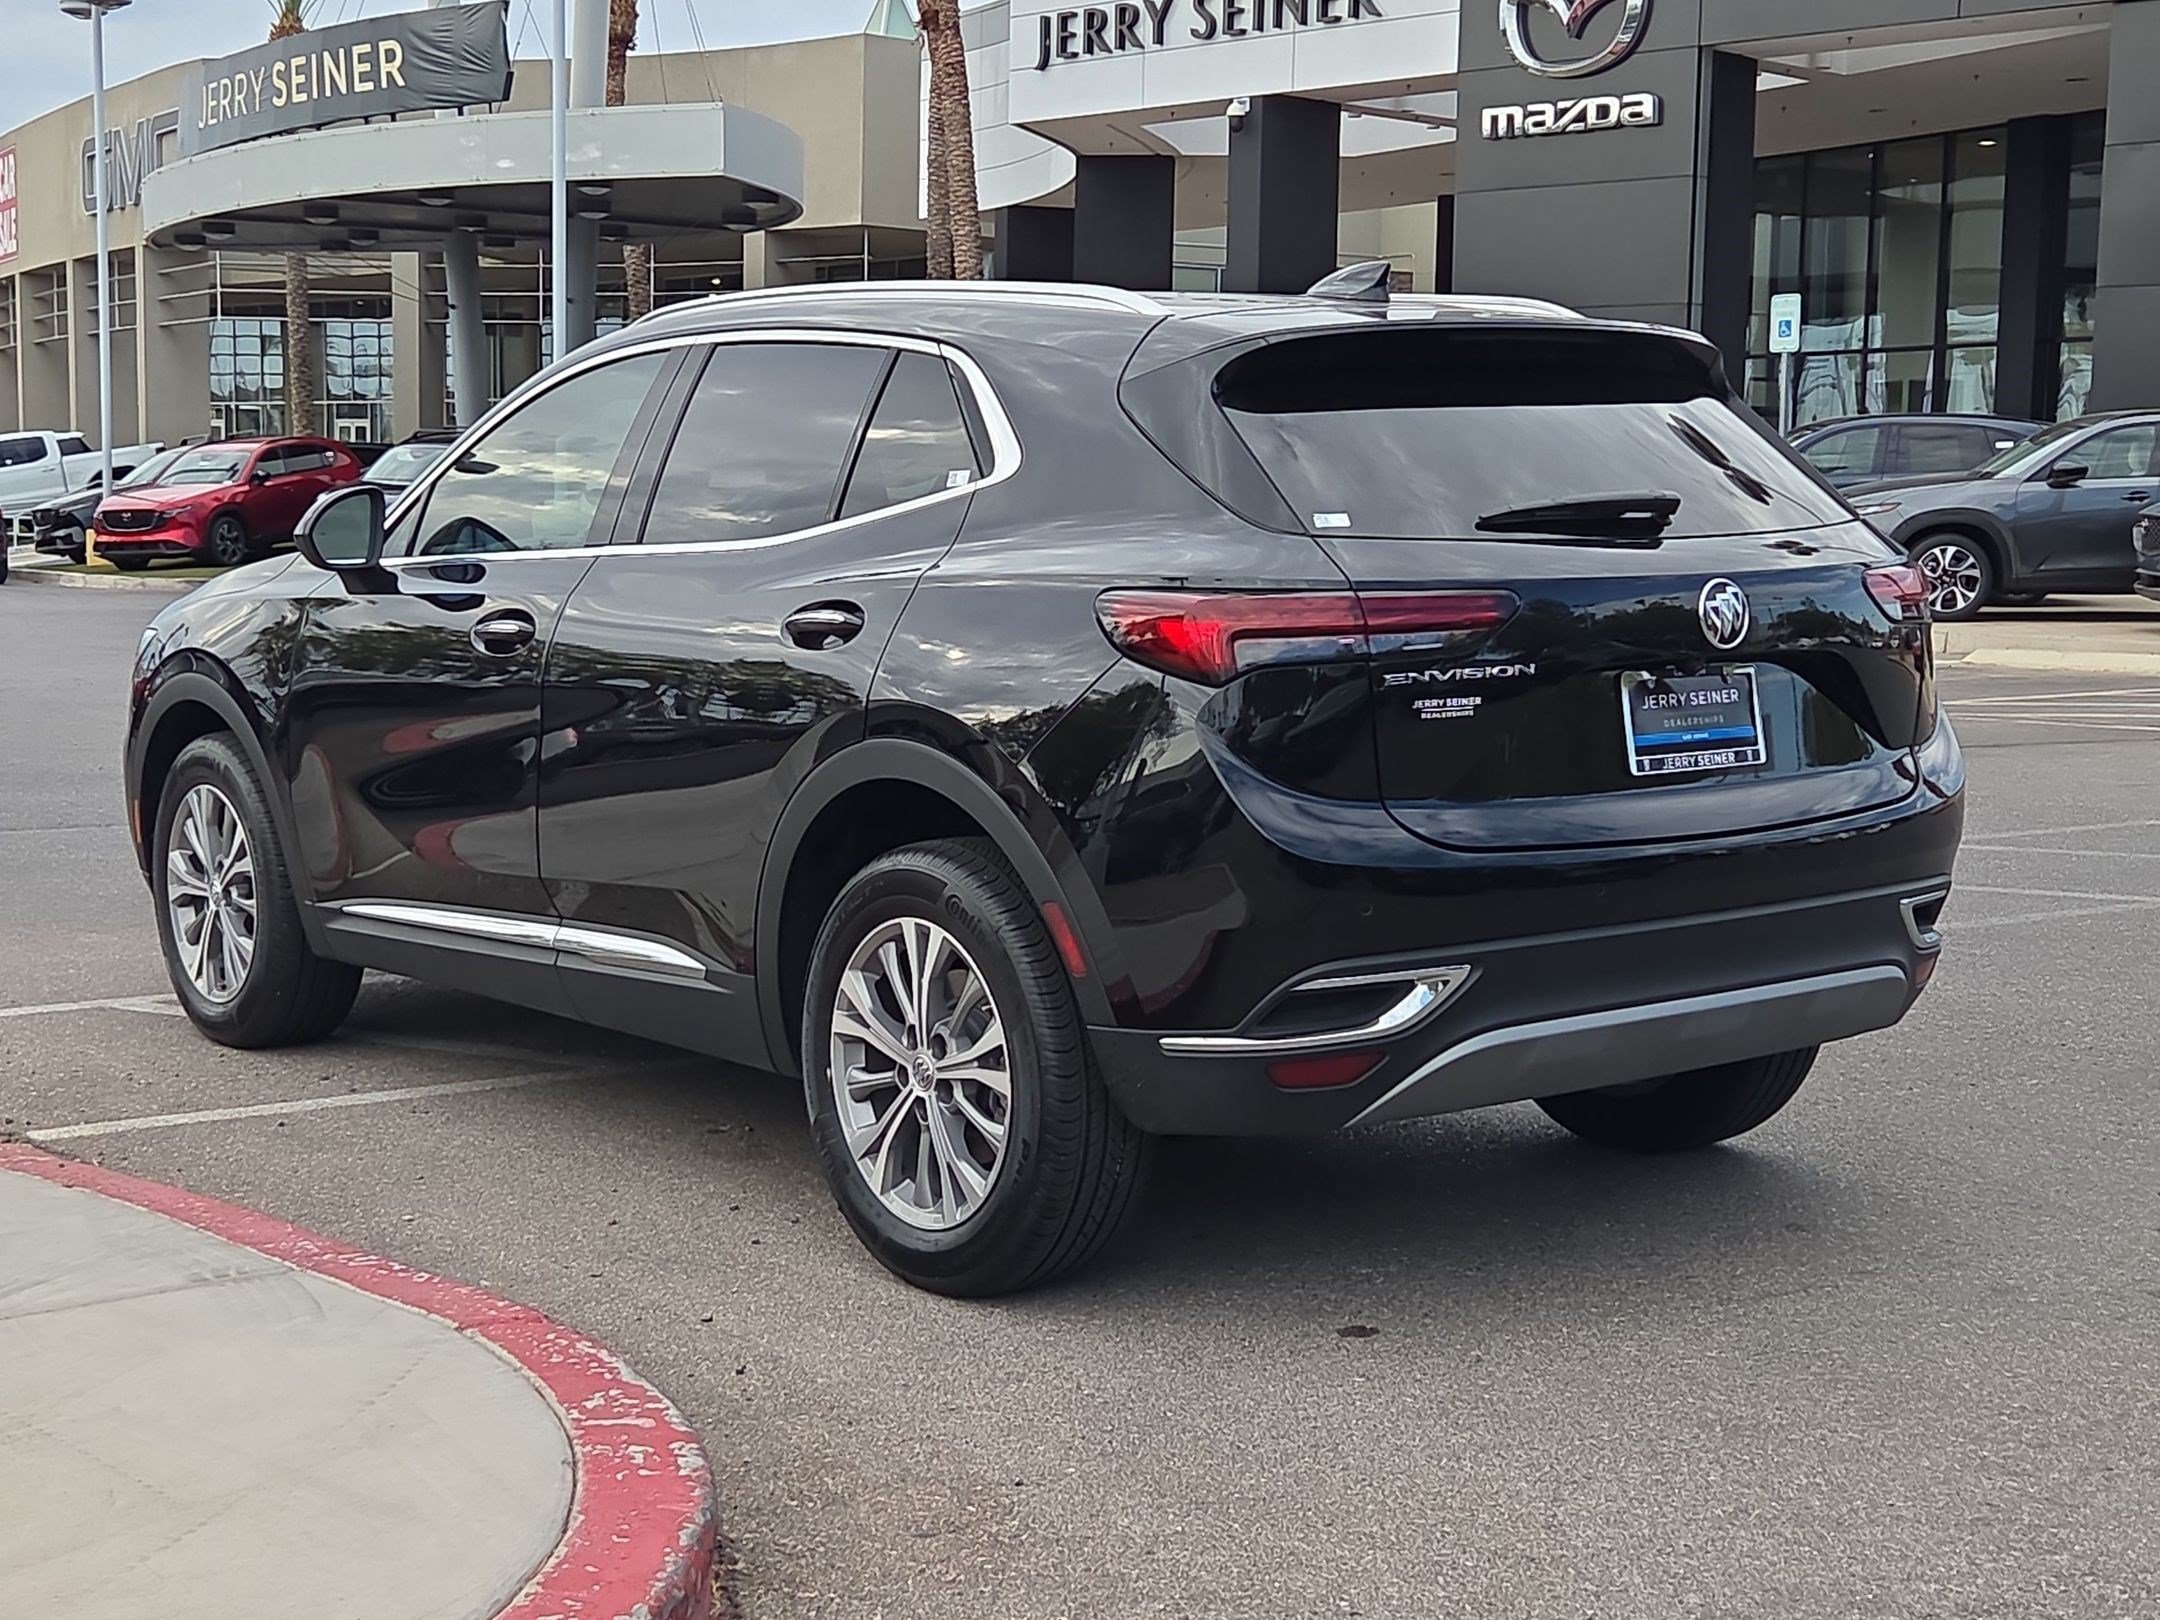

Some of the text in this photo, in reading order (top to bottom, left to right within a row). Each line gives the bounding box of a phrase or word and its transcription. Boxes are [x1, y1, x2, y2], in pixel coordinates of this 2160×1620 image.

[1034, 0, 1174, 71] JERRY
[198, 39, 406, 129] JERRY SEINER
[1382, 663, 1536, 686] ENVISION
[1412, 696, 1482, 709] JERRY SEINER
[1642, 688, 1740, 710] JERRY SEINER
[1663, 714, 1725, 728] DEALERSHIPS
[1662, 752, 1736, 770] JERRY SEINER
